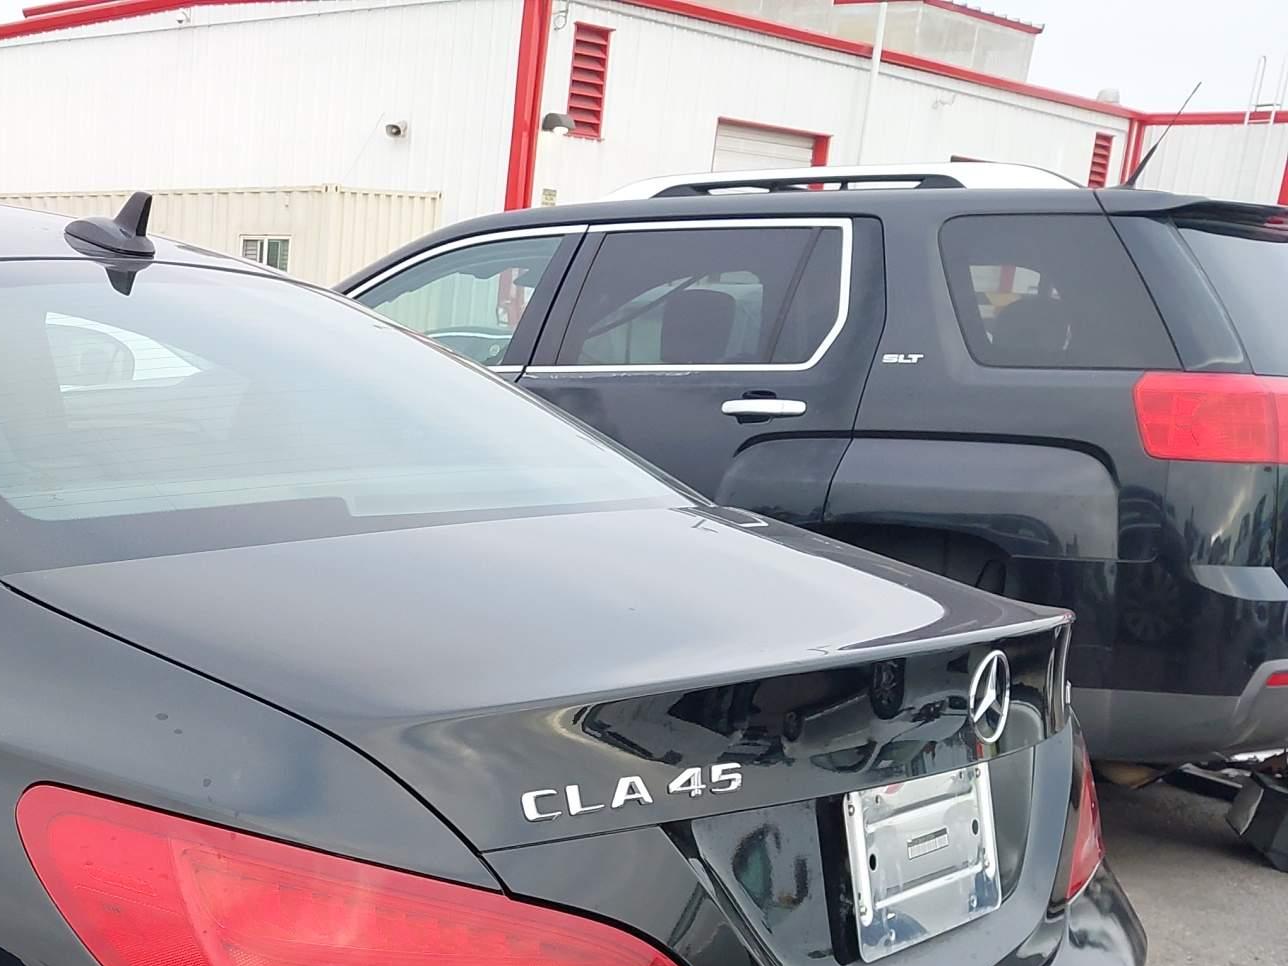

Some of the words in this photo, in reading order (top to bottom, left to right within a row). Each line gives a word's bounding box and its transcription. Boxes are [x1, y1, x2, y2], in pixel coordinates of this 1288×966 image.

[882, 353, 924, 363] SLT
[521, 775, 654, 822] CLA
[667, 762, 743, 798] 45
